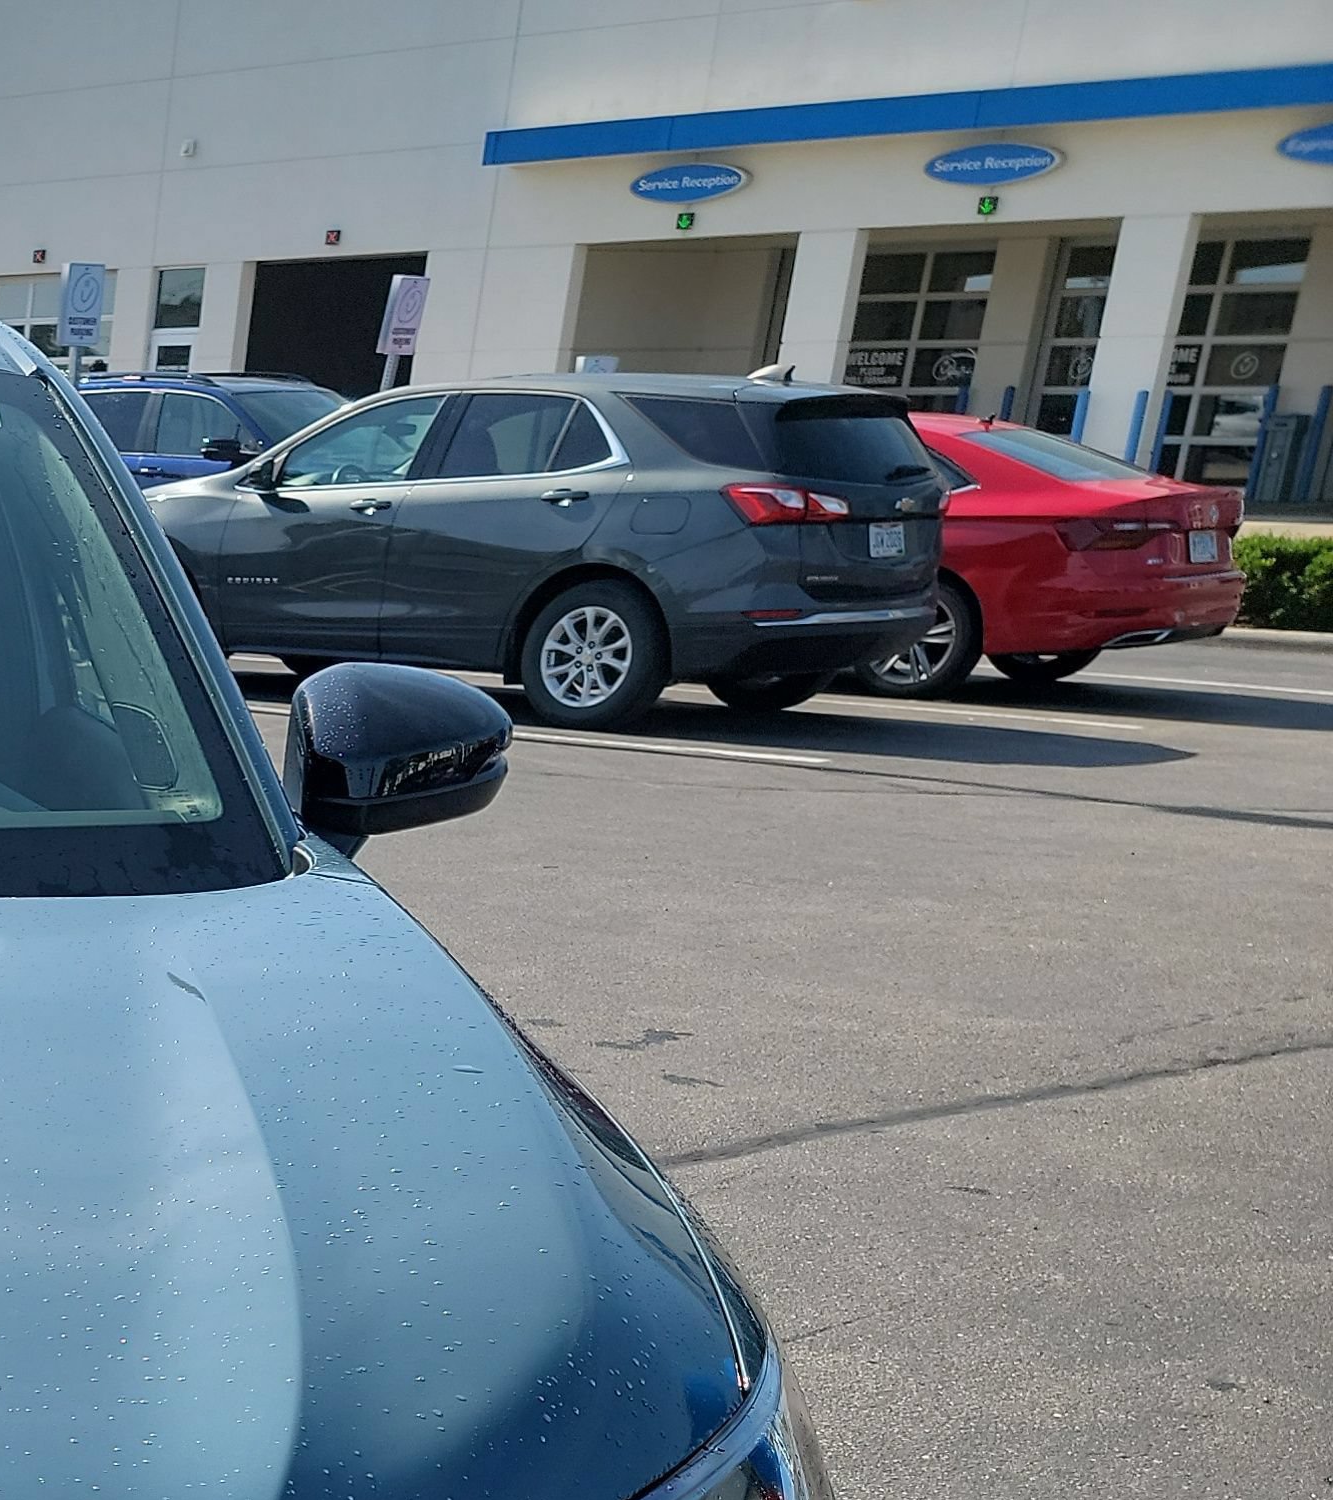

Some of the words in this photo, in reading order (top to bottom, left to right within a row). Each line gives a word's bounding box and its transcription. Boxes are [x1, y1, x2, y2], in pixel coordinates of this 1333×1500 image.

[934, 158, 982, 173] Service
[985, 154, 1051, 171] Reception
[638, 178, 679, 192] Service
[682, 173, 740, 189] Reception
